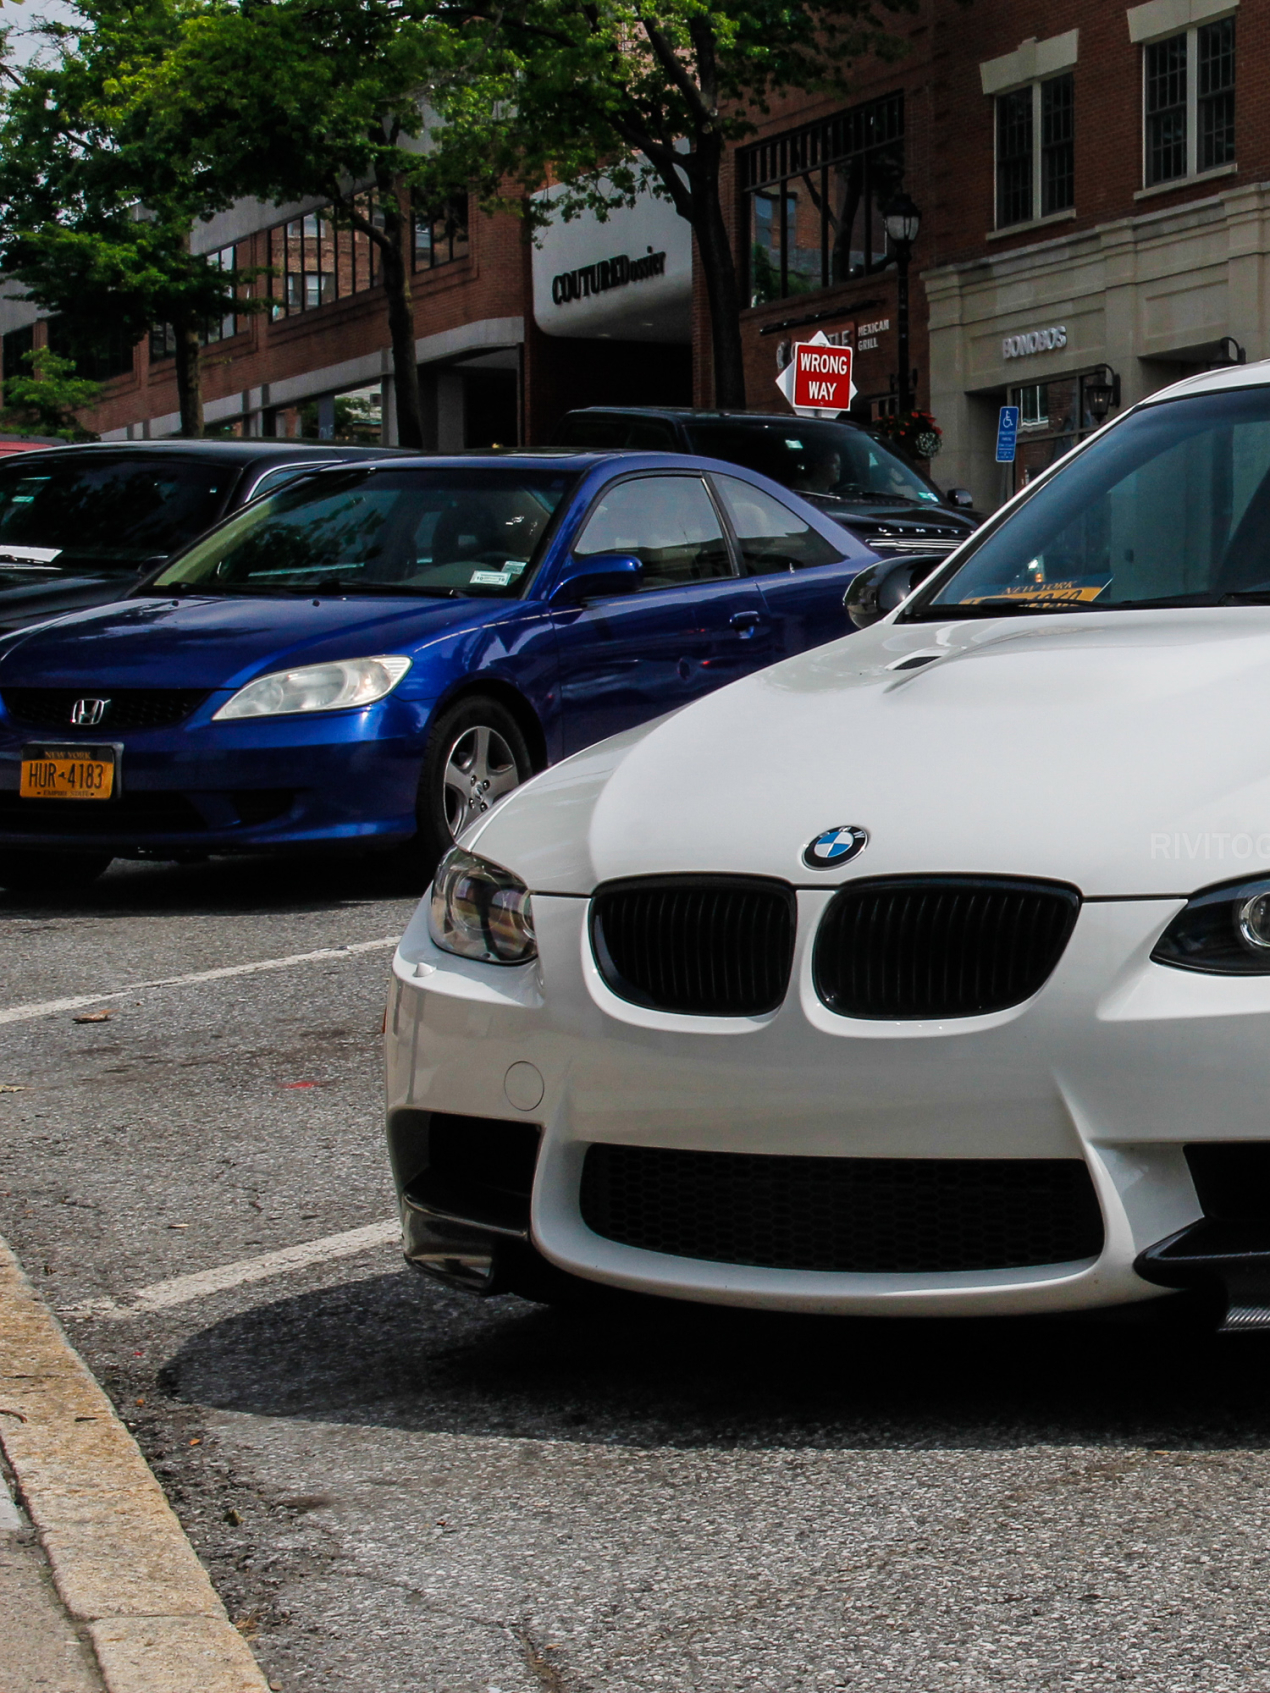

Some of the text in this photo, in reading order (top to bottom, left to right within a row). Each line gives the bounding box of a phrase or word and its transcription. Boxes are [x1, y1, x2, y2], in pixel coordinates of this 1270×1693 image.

[858, 319, 889, 337] MEXICAN
[858, 337, 878, 352] GRILL
[1002, 325, 1067, 360] BONOBOS
[800, 352, 848, 375] WRONG
[808, 381, 837, 401] WAY
[44, 751, 91, 759] NEW YORK
